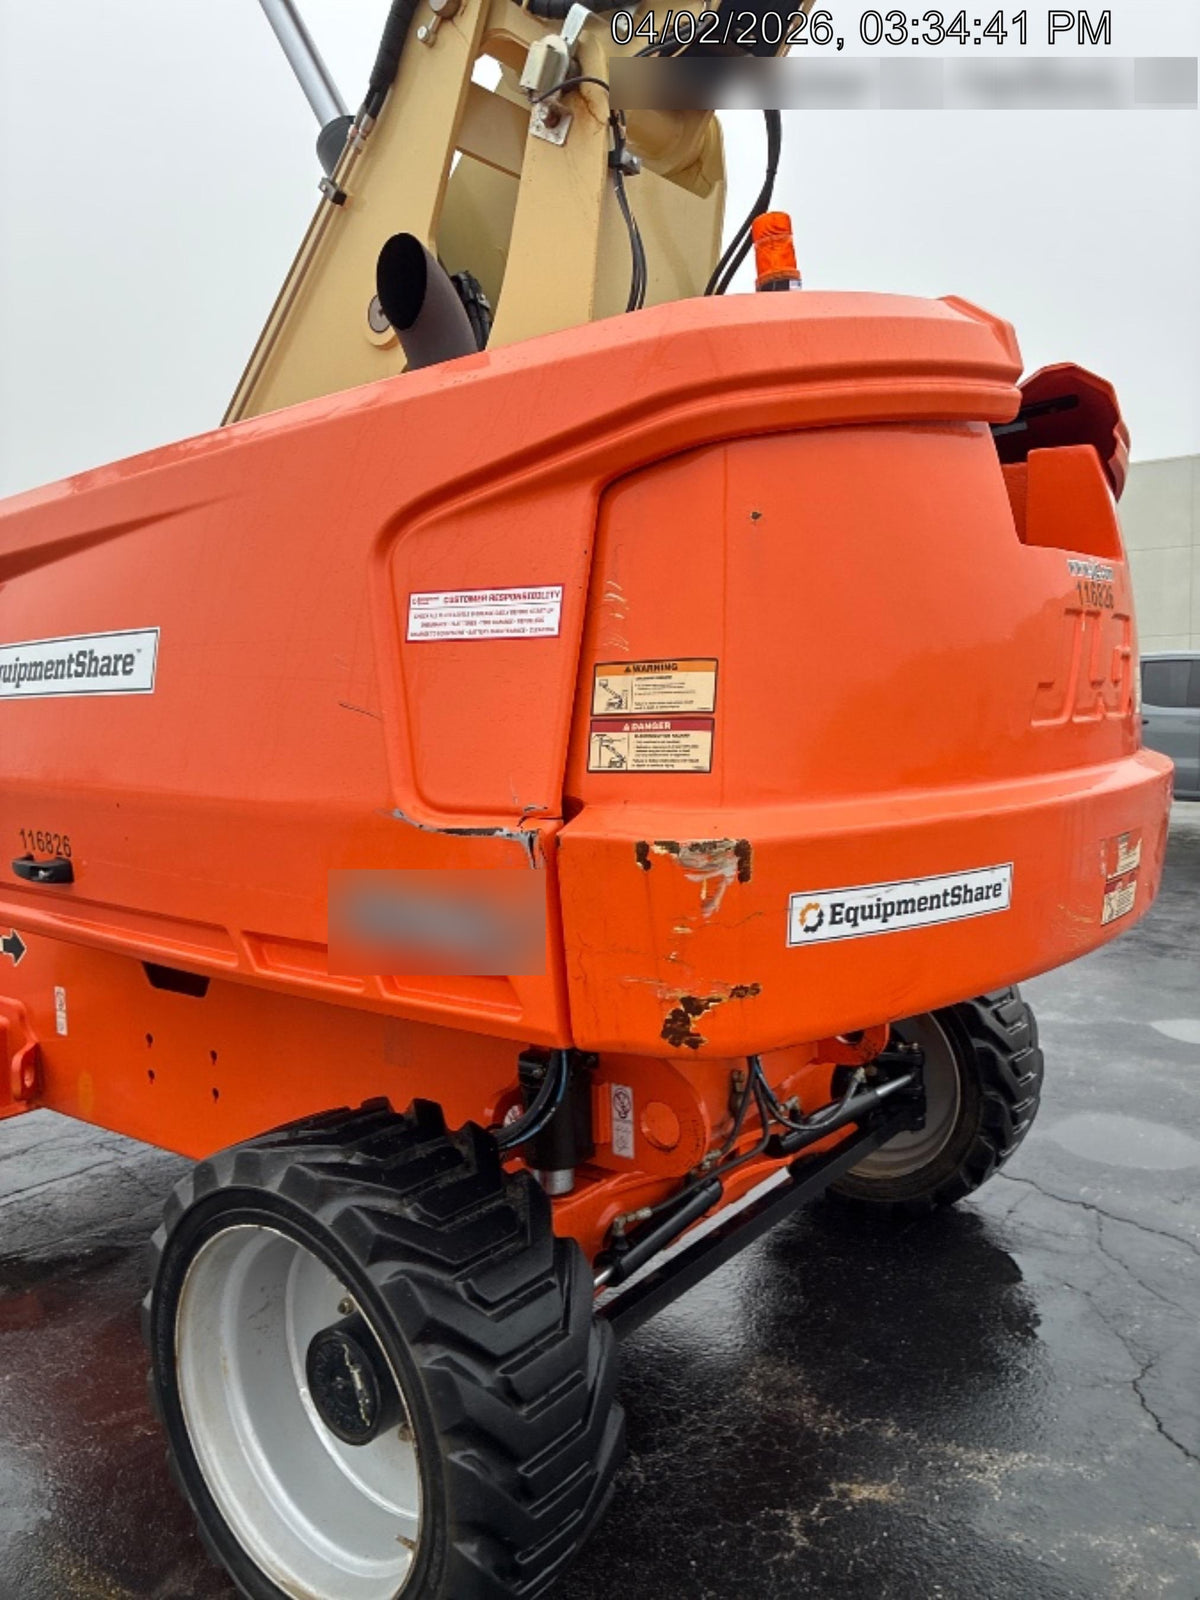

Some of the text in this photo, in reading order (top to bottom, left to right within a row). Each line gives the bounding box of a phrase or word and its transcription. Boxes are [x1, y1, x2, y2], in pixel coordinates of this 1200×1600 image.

[632, 663, 678, 673] WARNING
[630, 721, 672, 731] DANGER
[20, 828, 71, 858] 116826
[828, 882, 1003, 928] EquipmentShare
